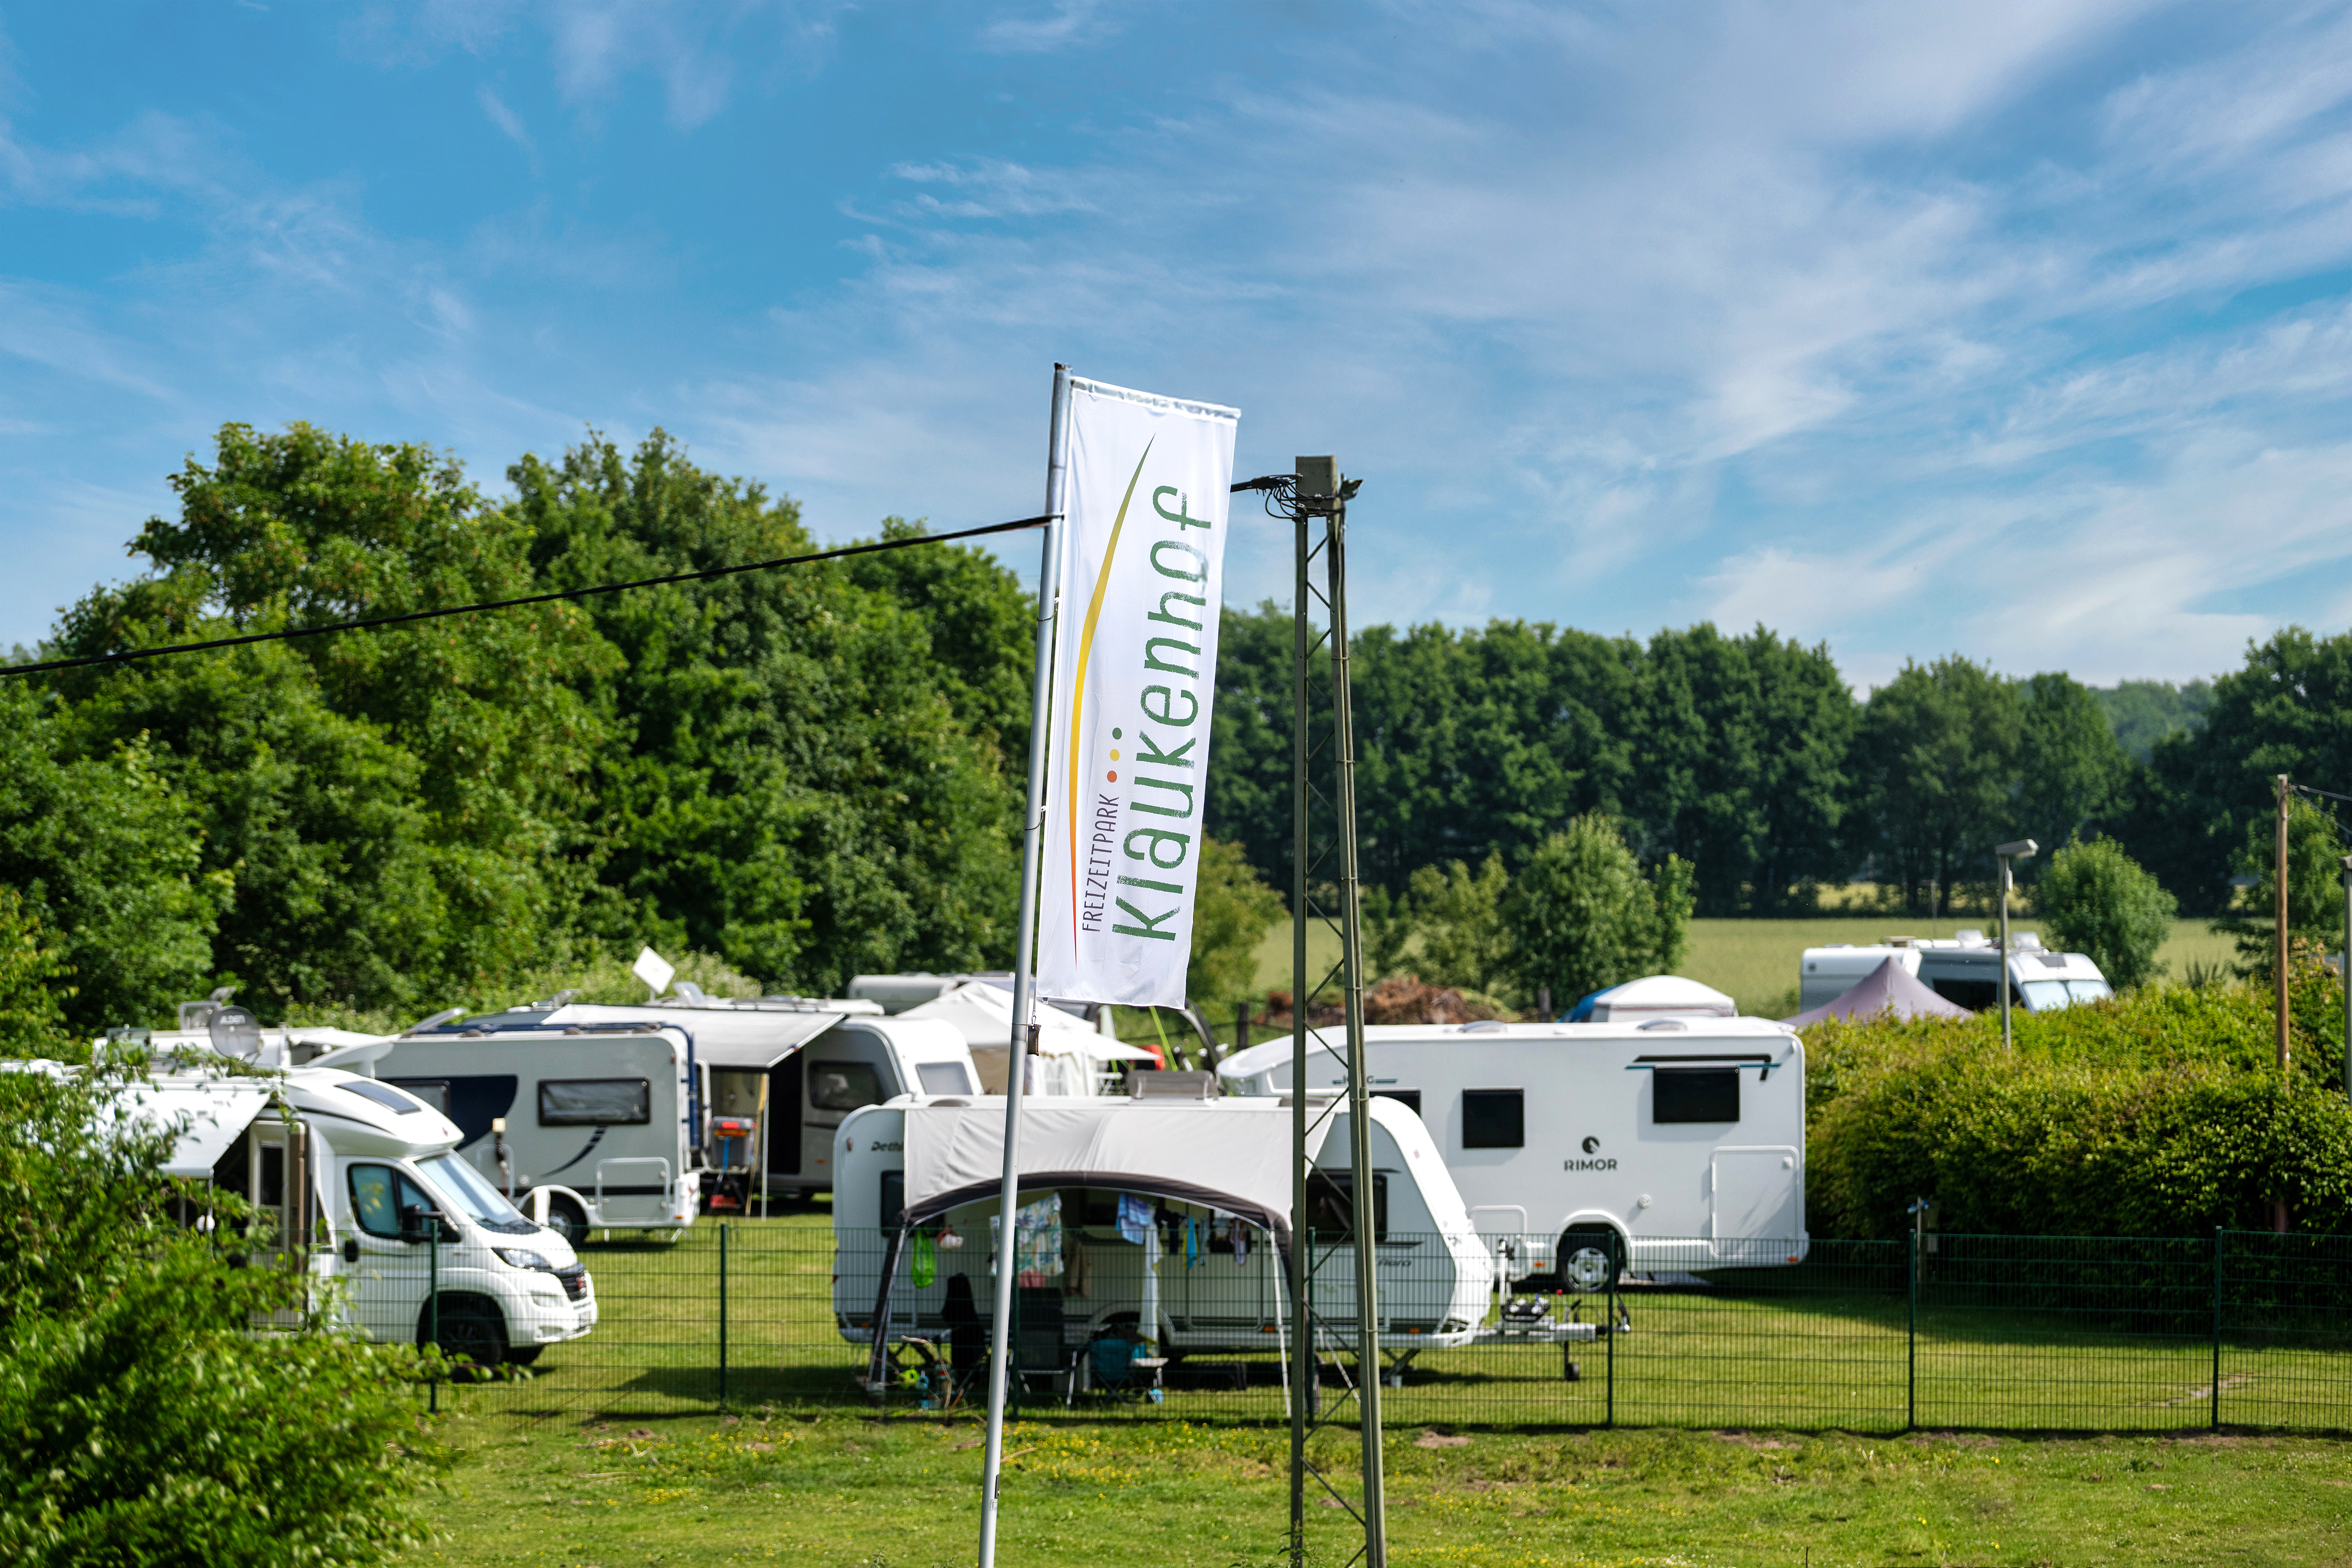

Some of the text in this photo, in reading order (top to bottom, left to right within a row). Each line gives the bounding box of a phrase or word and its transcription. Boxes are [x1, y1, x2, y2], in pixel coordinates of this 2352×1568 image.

[1112, 485, 1211, 941] Klaukenhof
[1082, 793, 1119, 932] FREIZEITPARK
[1564, 1158, 1617, 1170] RIMOR
